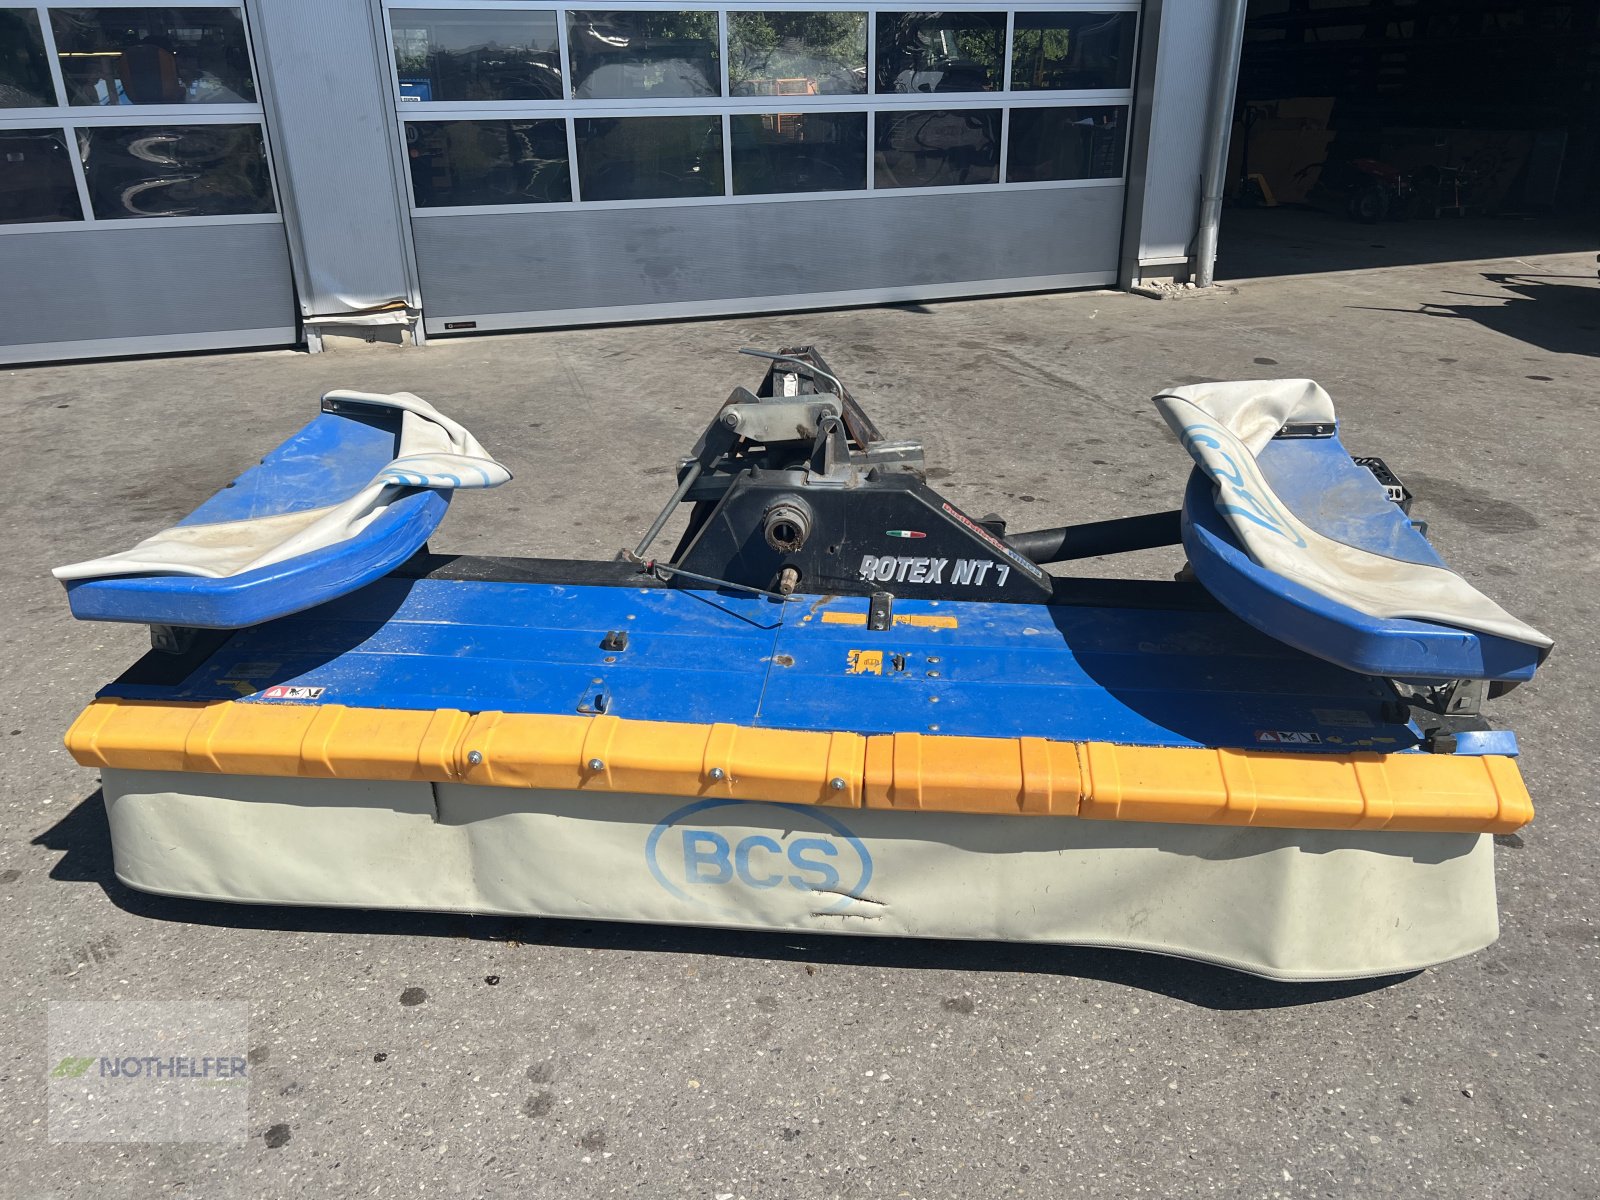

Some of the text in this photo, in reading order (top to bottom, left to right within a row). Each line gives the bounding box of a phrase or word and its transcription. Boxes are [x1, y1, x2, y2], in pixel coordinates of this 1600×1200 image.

[859, 554, 948, 584] ROTEX
[950, 558, 994, 586] NT
[682, 829, 840, 892] BCS
